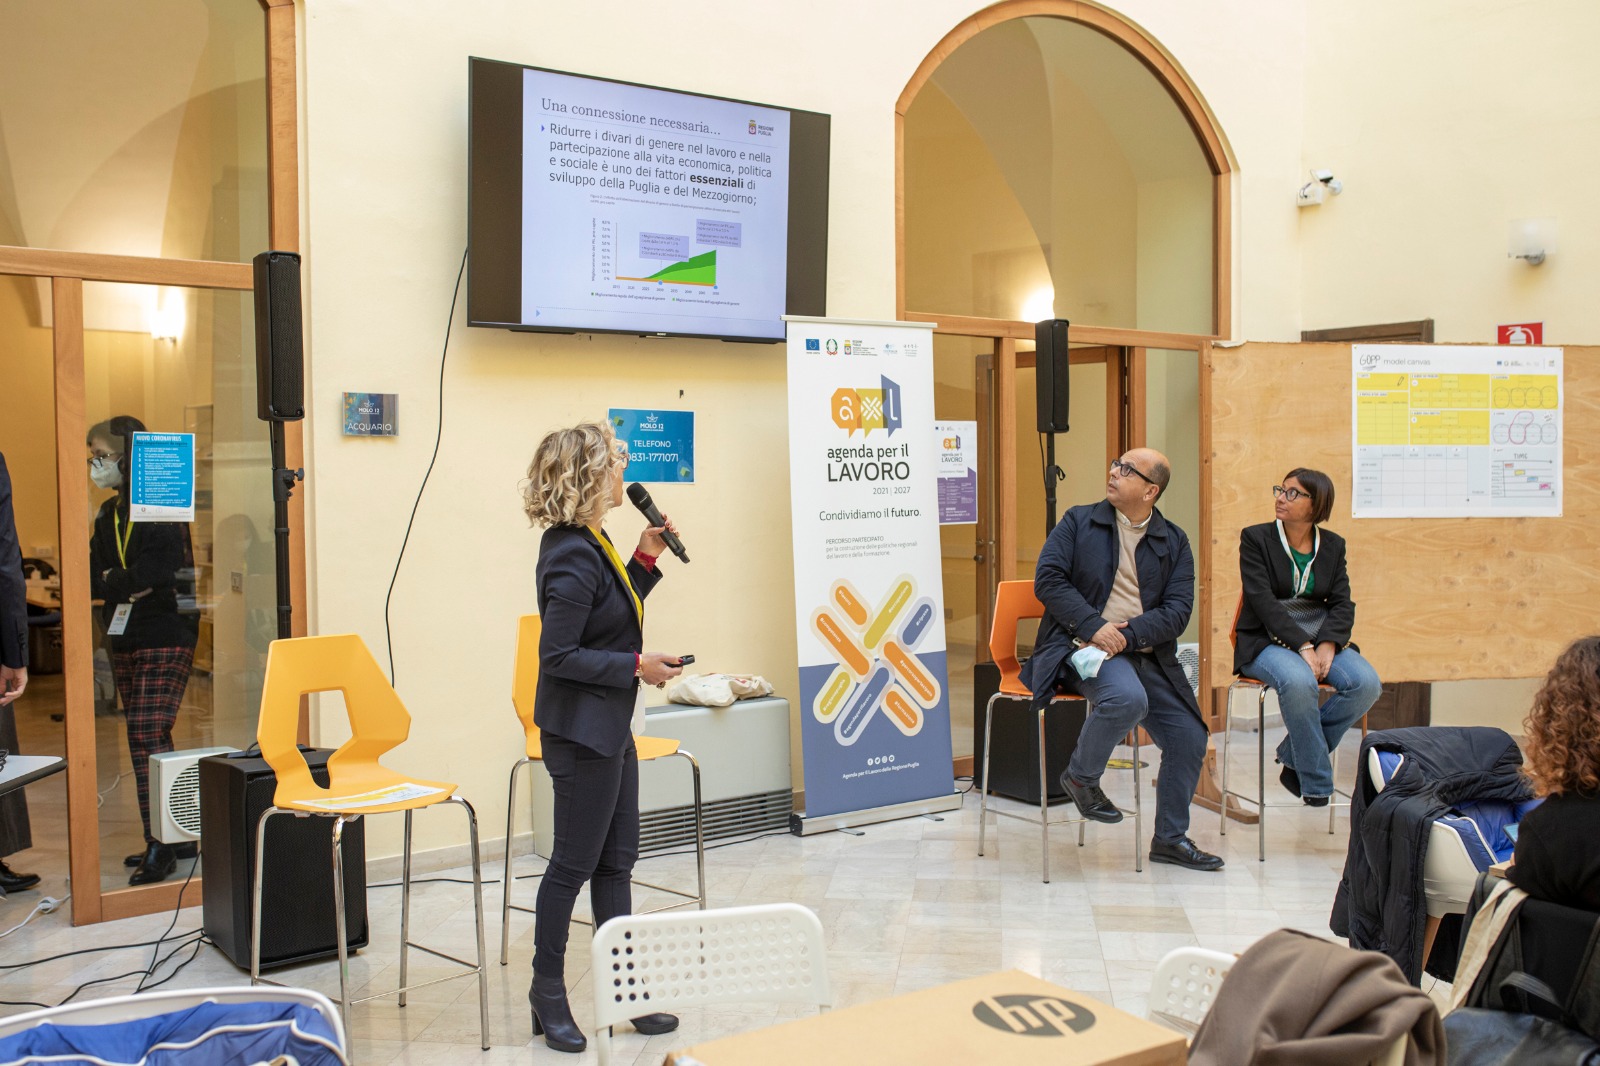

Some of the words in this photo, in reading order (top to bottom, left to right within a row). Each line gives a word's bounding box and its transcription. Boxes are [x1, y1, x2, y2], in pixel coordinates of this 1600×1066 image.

[541, 98, 567, 113] Una
[571, 105, 646, 124] connessione
[650, 117, 721, 135] necessaria...
[550, 123, 591, 138] Ridurre
[602, 130, 631, 144] divari
[635, 135, 645, 146] di
[649, 139, 684, 151] genere
[688, 143, 703, 153] nel
[706, 145, 736, 158] lavoro
[749, 152, 771, 163] nella
[550, 141, 630, 159] partecipazione
[634, 151, 652, 162] alla
[656, 155, 675, 165] vita
[678, 158, 734, 174] economica,
[738, 165, 772, 178] politica
[550, 157, 556, 165] e
[560, 158, 598, 171] sociale
[602, 160, 608, 172] è
[612, 164, 632, 175] uno
[636, 166, 651, 177] dei
[655, 168, 686, 181] fattori
[690, 174, 744, 188] essenziali
[747, 180, 756, 190] di
[549, 172, 596, 187] sviluppo
[600, 177, 625, 189] della
[629, 180, 660, 194] Puglia
[664, 186, 670, 194] e
[674, 185, 688, 196] del
[692, 187, 757, 206] Mezzogiorno;
[1360, 354, 1380, 366] GOPP
[348, 423, 392, 431] ACQUARIO
[827, 444, 874, 462] agenda
[878, 447, 898, 462] per
[900, 443, 908, 457] il
[827, 462, 910, 482] LAVORO
[873, 487, 888, 495] 2021
[894, 486, 911, 494] 2027
[819, 509, 882, 521] Condividiamo
[884, 508, 889, 517] il
[891, 508, 921, 517] futuro.
[878, 542, 897, 550] politiche
[843, 772, 857, 780] Agenda
[981, 994, 1078, 1037] hp
